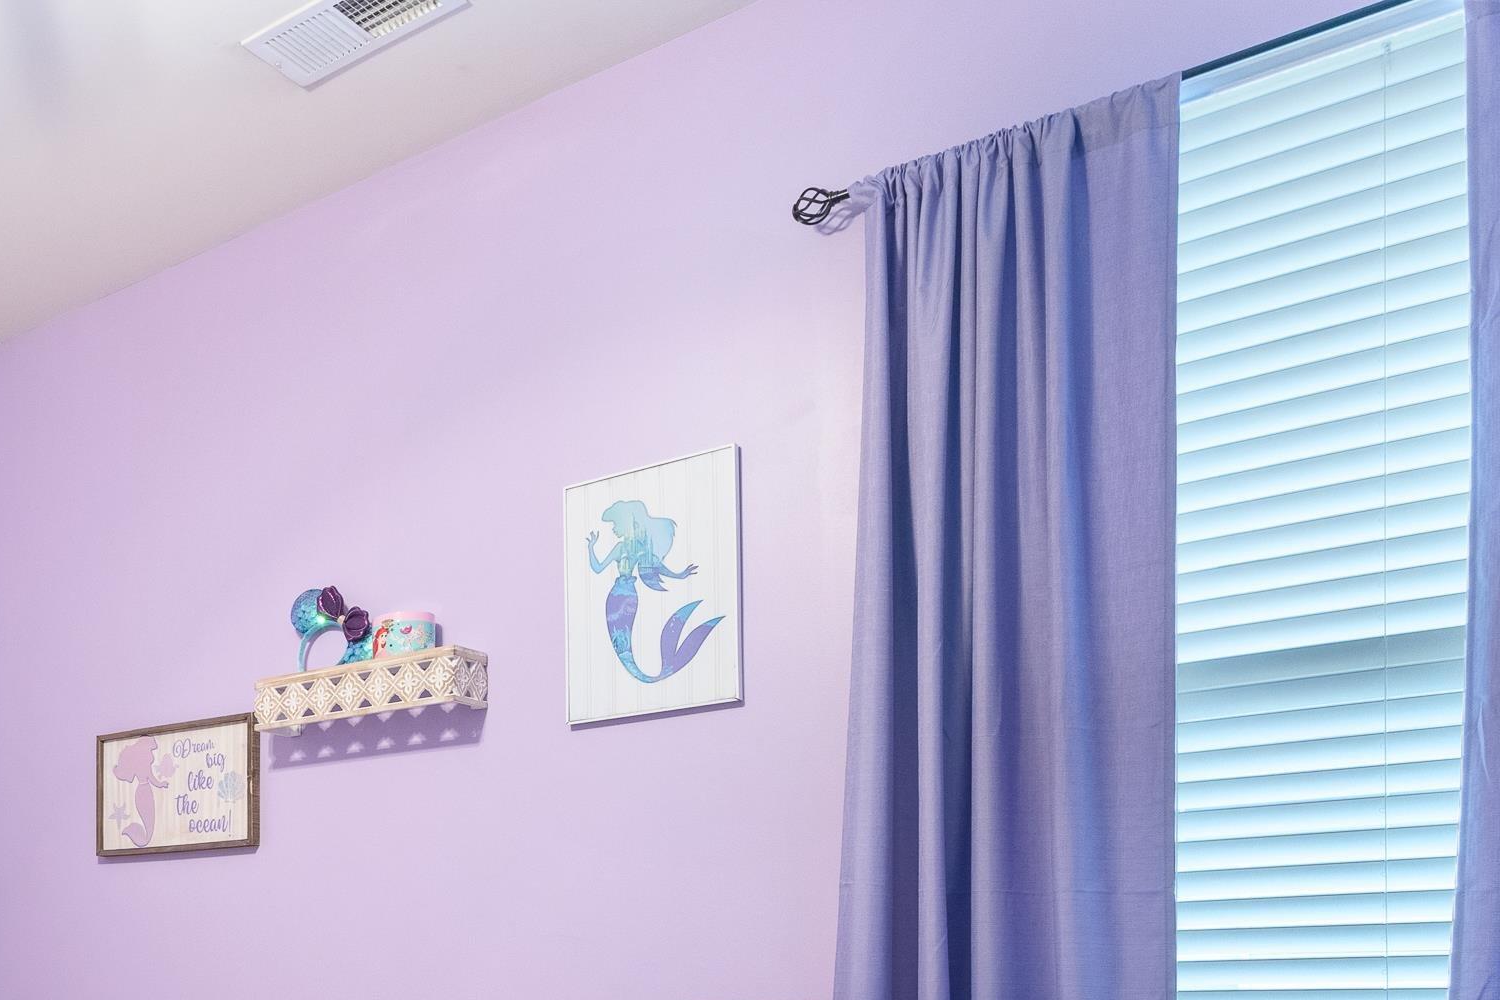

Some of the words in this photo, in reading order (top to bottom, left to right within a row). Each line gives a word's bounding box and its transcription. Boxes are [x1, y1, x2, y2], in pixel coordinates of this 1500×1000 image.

[205, 752, 227, 773] big
[187, 769, 214, 792] like
[174, 793, 199, 816] the
[188, 808, 232, 838] ocean!
